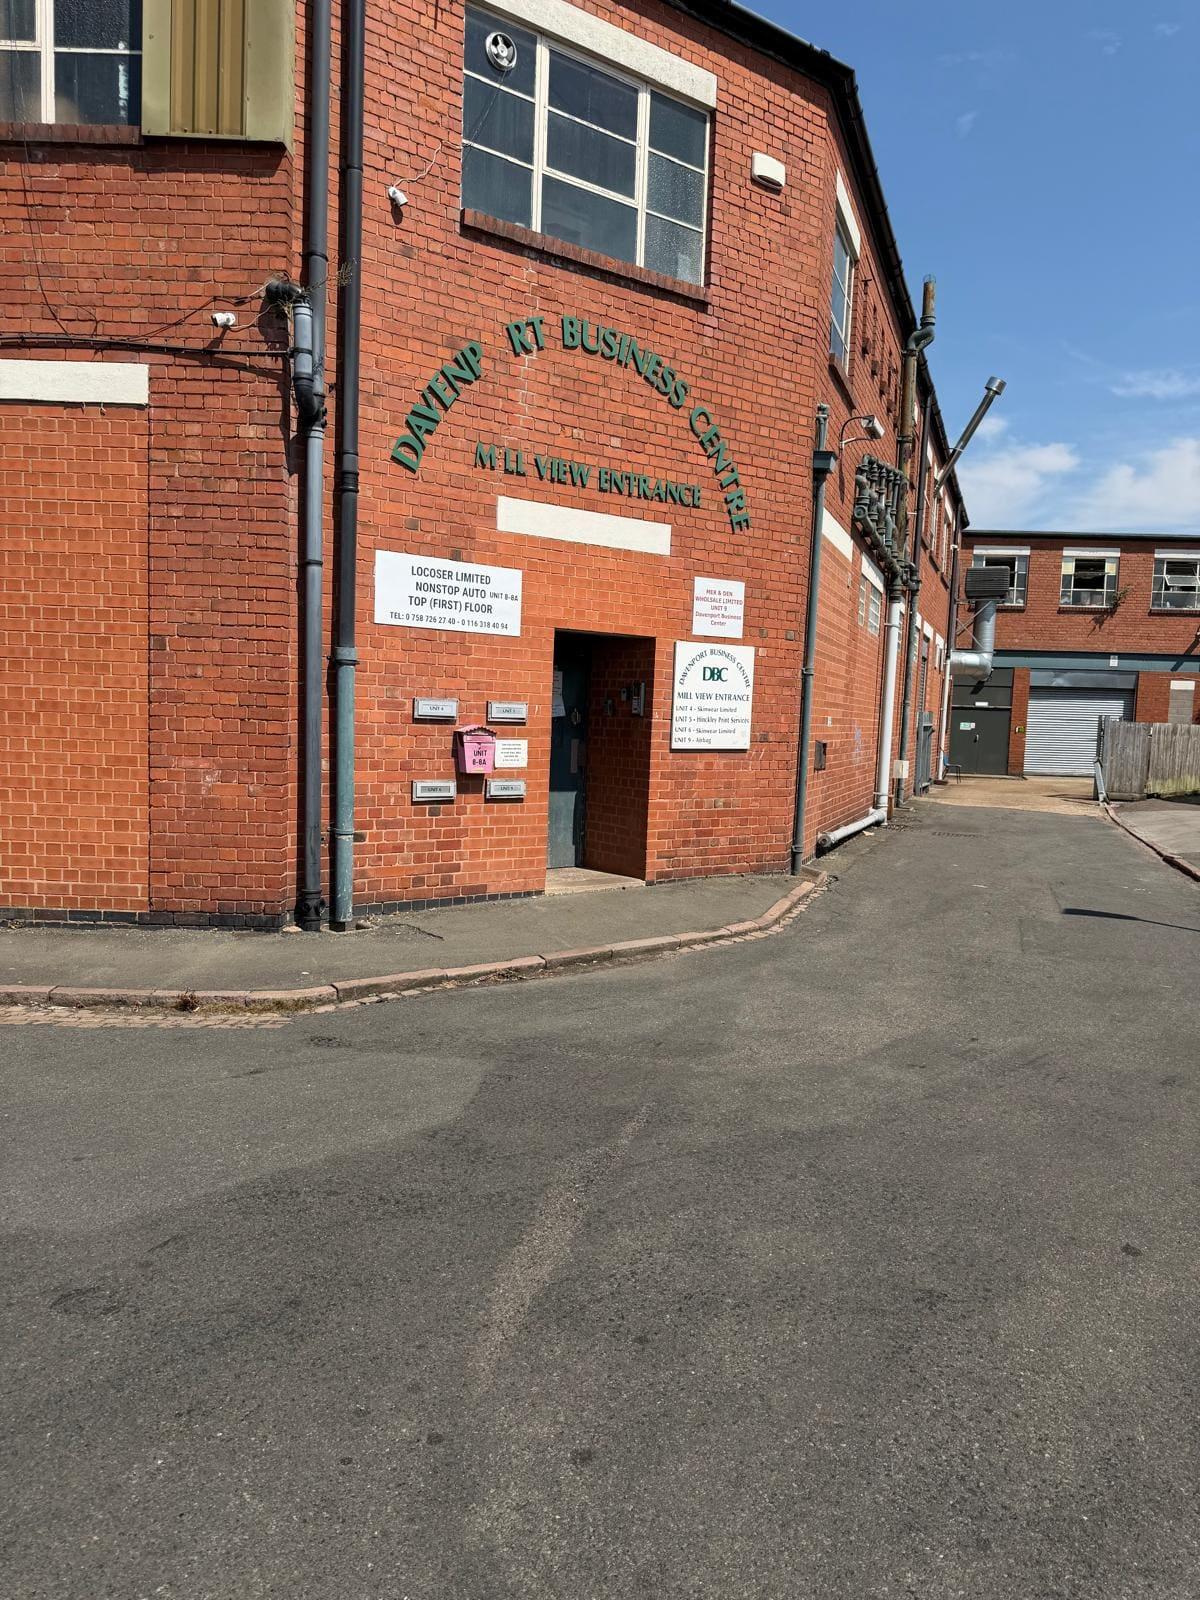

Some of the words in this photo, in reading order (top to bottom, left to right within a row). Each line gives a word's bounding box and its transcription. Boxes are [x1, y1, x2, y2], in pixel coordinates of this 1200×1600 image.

[561, 315, 691, 409] BUSINESS
[689, 406, 751, 534] CENTRE
[474, 441, 526, 476] MLL
[535, 455, 592, 489] VIEW
[599, 469, 701, 508] ENTRANCE
[411, 566, 453, 580] LOCOSER
[455, 572, 491, 585] LIMITED
[416, 581, 460, 596] NONSTOP
[462, 588, 486, 599] AUTO
[490, 591, 503, 599] UNIT
[408, 595, 427, 607] TOP
[429, 598, 463, 613] (FIRST)
[464, 602, 493, 614] FLOOR
[723, 598, 743, 606] LIMITED
[390, 611, 404, 620] TEL:
[405, 613, 410, 621] 0
[412, 613, 424, 622] 758
[425, 614, 437, 623] 726
[438, 616, 446, 624] 27
[448, 617, 456, 625] 40
[461, 618, 466, 626] 0
[467, 619, 479, 627] 116
[479, 620, 491, 629] 318
[491, 621, 500, 629] 40
[501, 622, 509, 630] 94
[695, 611, 720, 619] Davenport
[679, 650, 708, 685] DAVENPORT
[709, 649, 737, 663] BUSINESS
[736, 661, 751, 688] CENTRE
[702, 666, 729, 682] DBC
[677, 692, 693, 700] MILL
[695, 692, 714, 701] VIEW
[715, 693, 750, 702] ENTRANCE
[473, 749, 487, 757] UNIT
